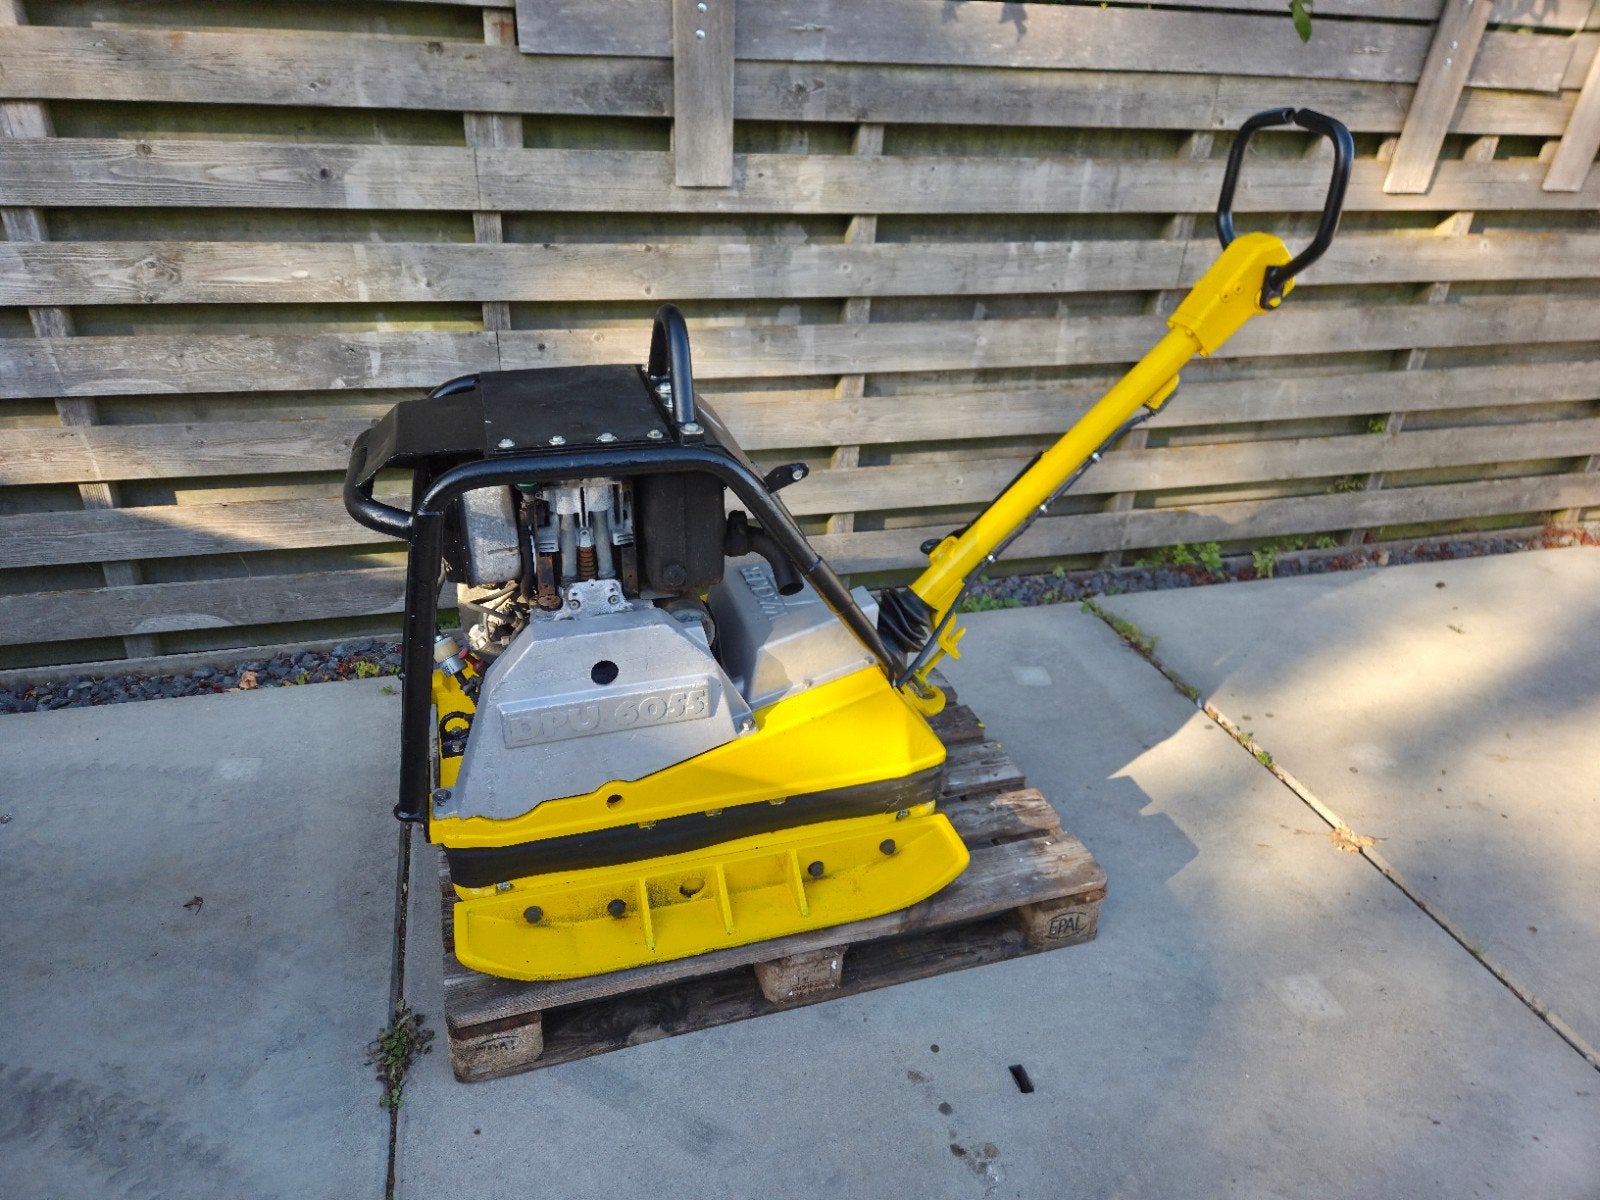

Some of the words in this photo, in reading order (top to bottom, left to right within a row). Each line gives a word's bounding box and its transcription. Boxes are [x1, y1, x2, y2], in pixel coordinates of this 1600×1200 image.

[508, 706, 601, 742] DPU
[613, 689, 706, 726] 6055
[1048, 914, 1082, 936] EPAL
